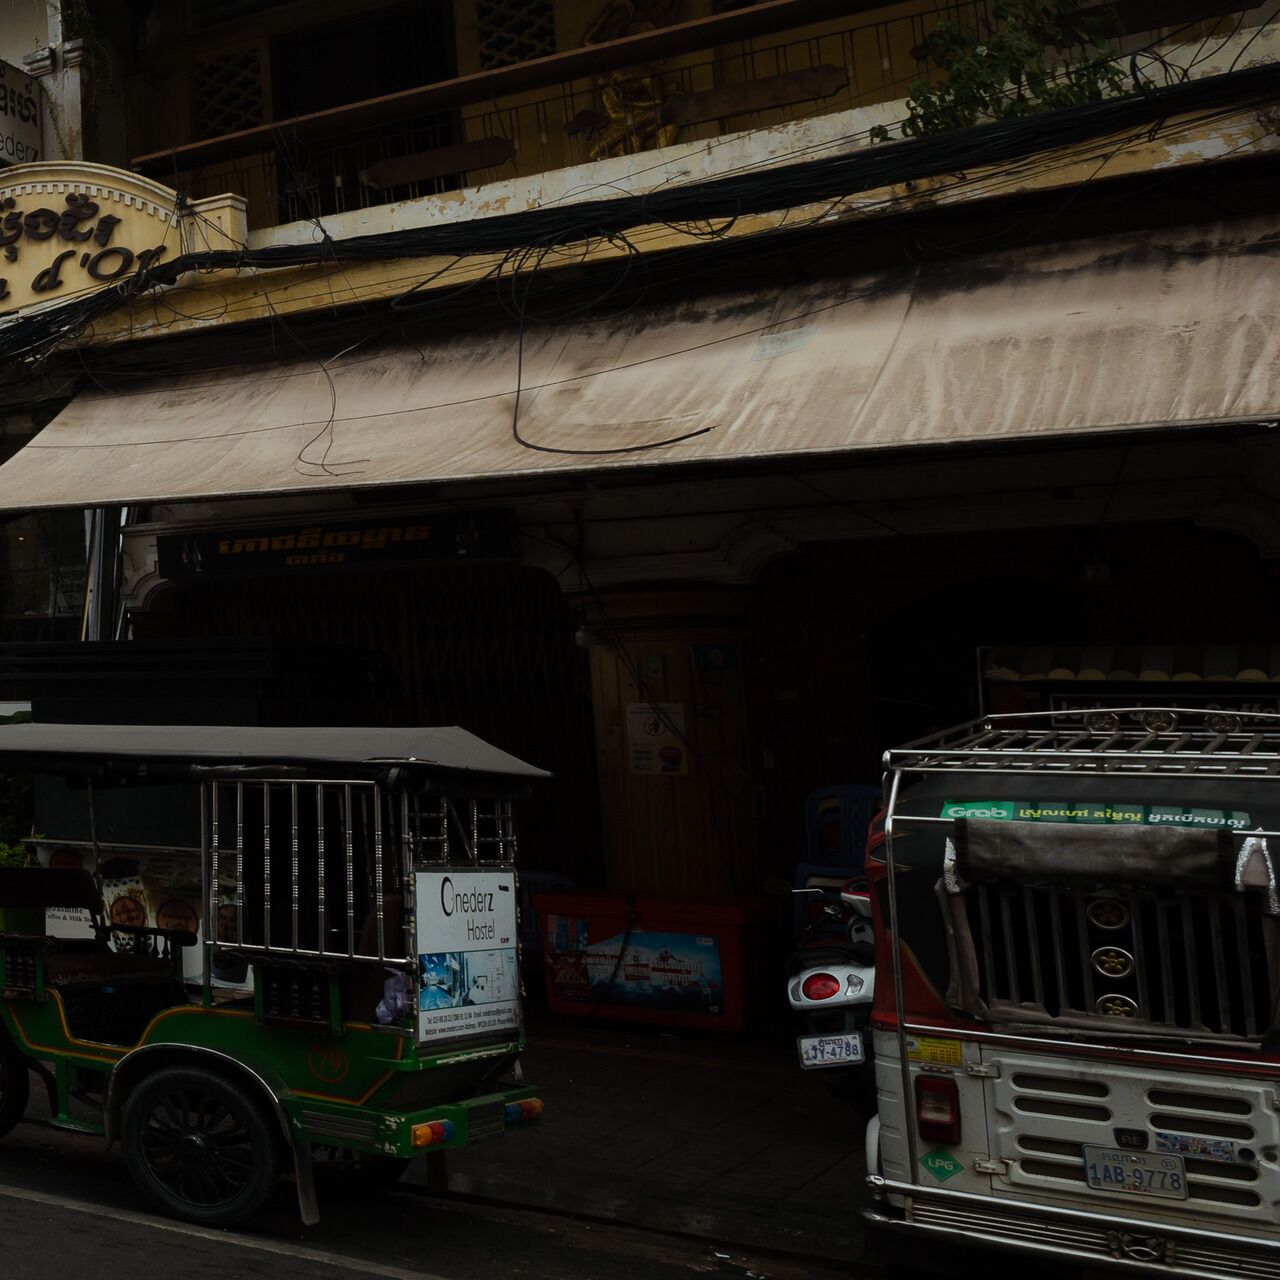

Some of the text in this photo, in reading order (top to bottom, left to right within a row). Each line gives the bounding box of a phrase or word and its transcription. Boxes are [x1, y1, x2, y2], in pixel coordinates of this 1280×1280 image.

[947, 806, 1008, 818] Grab
[441, 876, 495, 917] Onederz
[467, 919, 496, 941] Hostel
[928, 1155, 955, 1171] LPG
[1090, 1162, 1183, 1192] 1AB-9778
